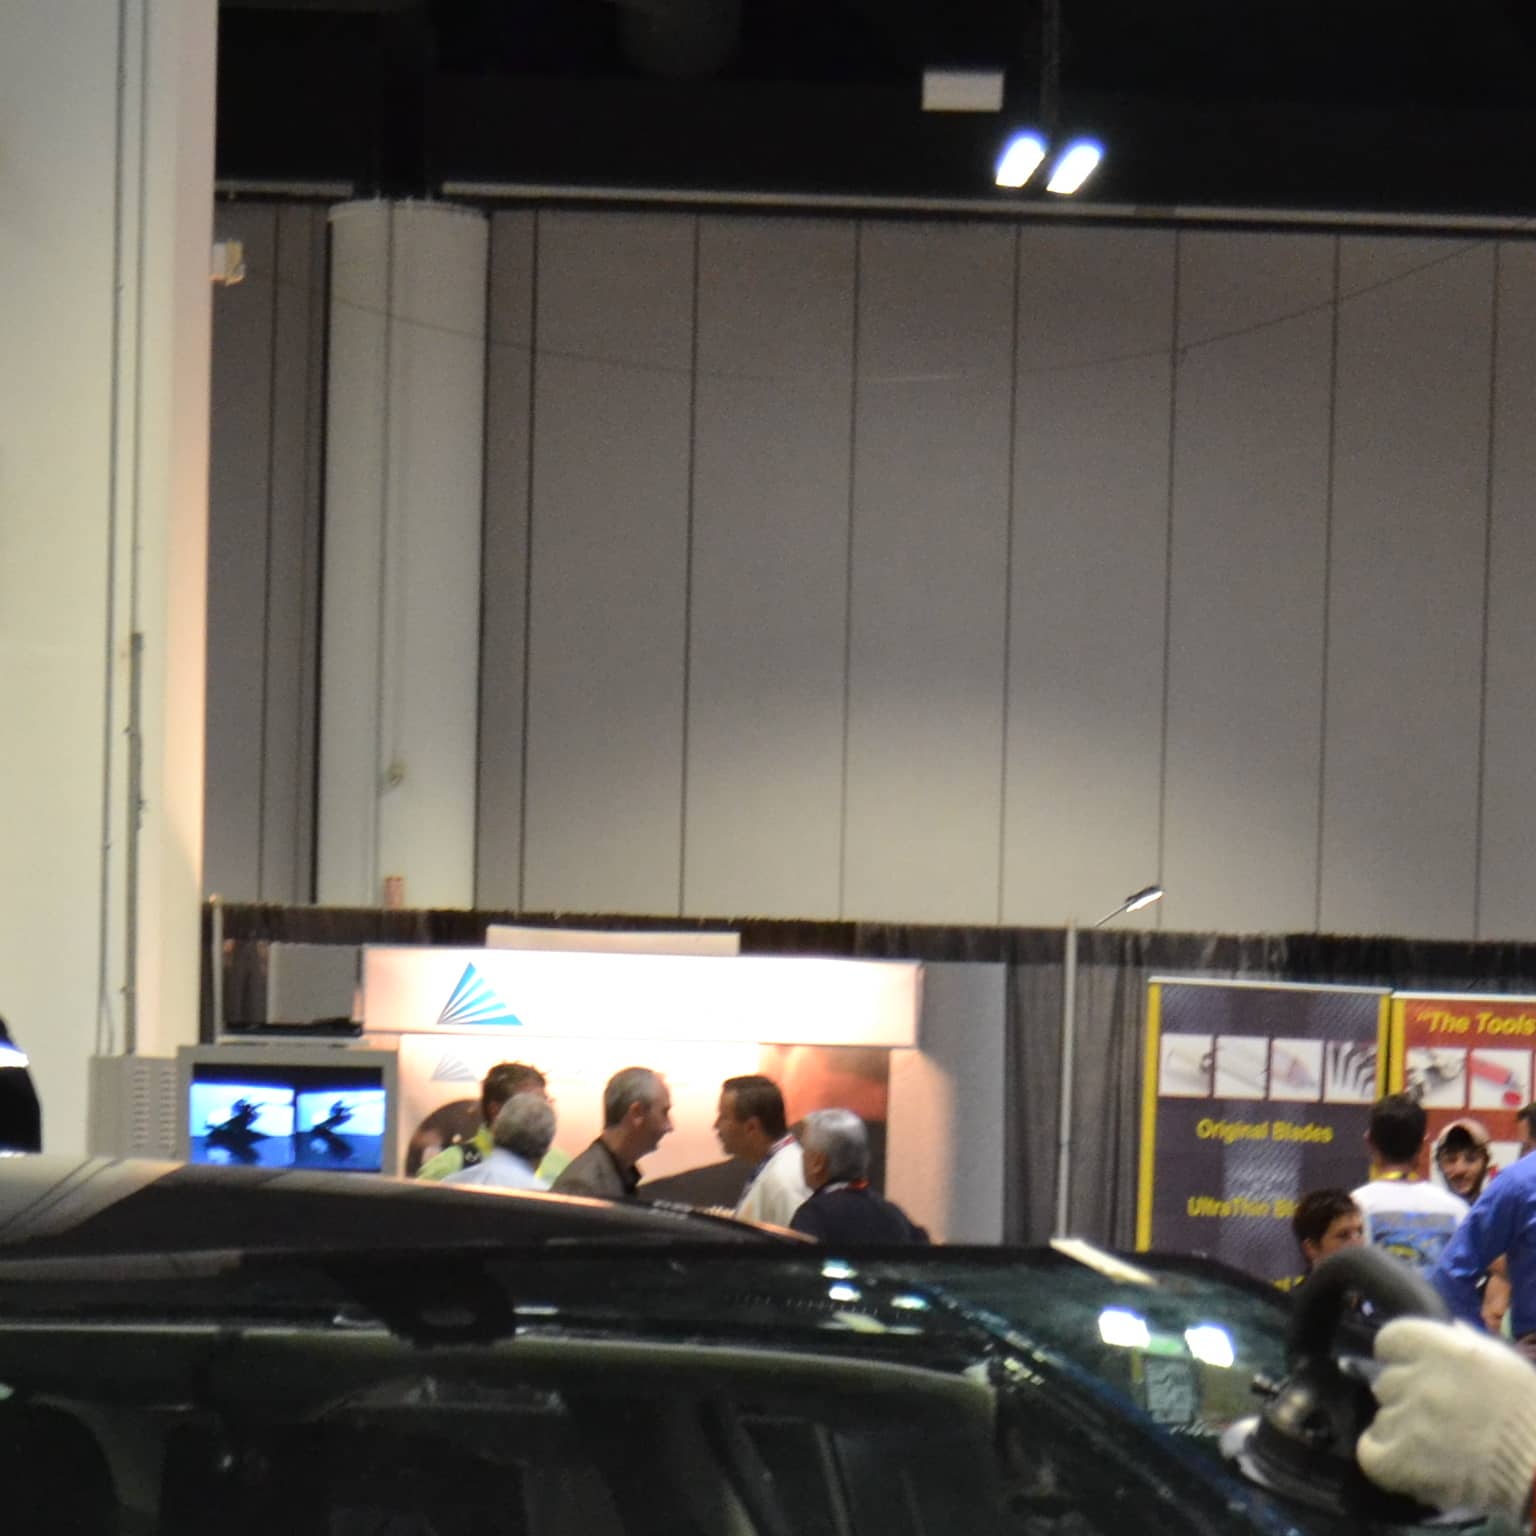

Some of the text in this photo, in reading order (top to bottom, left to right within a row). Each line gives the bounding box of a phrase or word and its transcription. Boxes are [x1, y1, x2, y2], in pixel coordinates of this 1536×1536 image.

[1476, 1012, 1536, 1036] Tools
[1196, 1118, 1333, 1144] Original Blades
